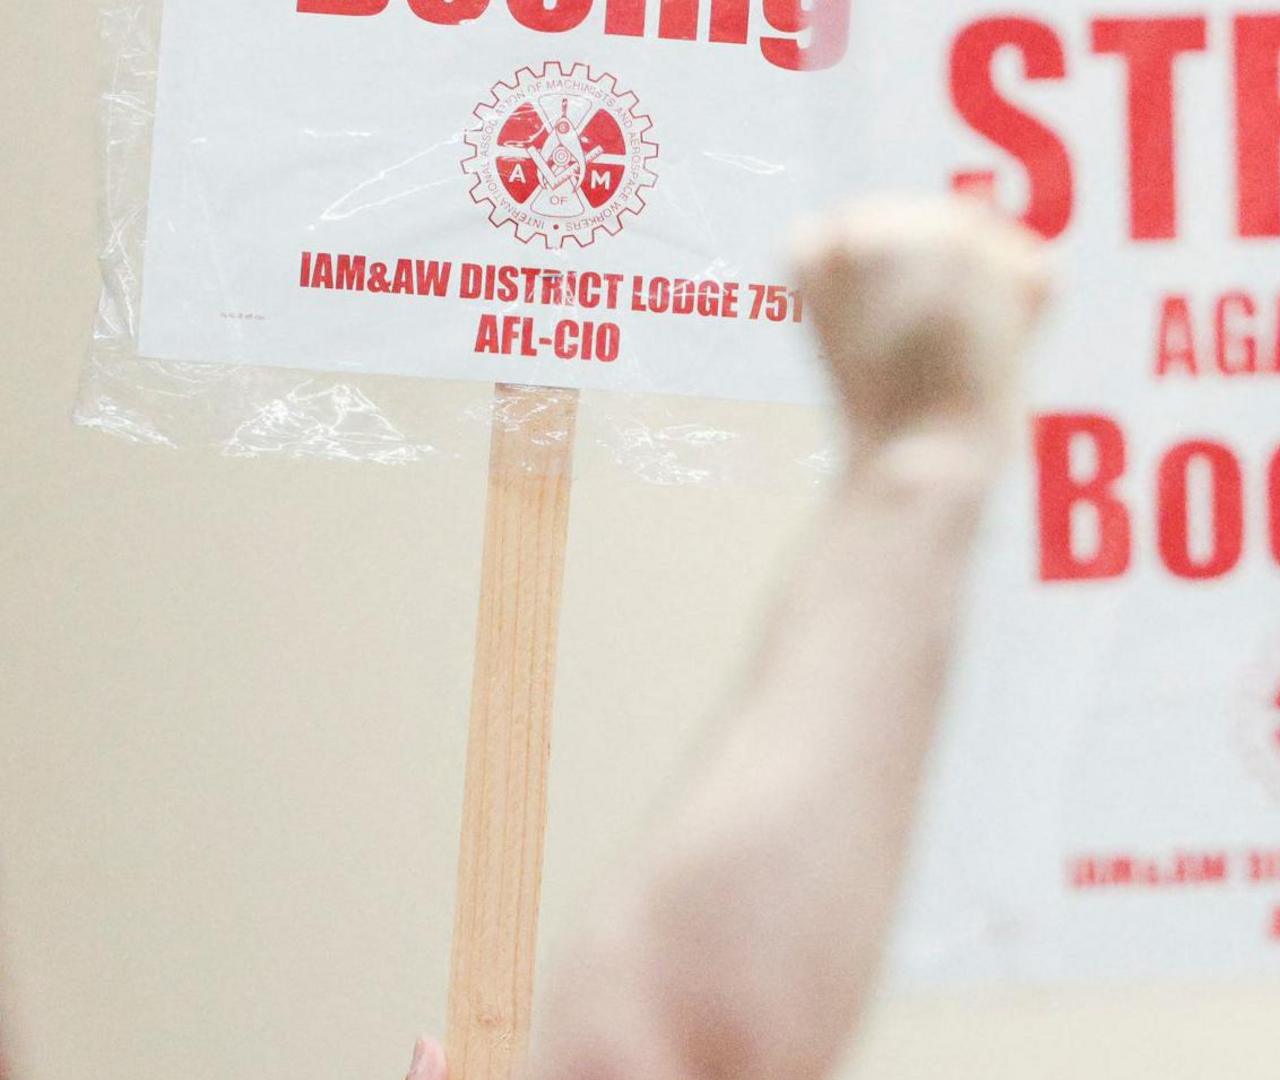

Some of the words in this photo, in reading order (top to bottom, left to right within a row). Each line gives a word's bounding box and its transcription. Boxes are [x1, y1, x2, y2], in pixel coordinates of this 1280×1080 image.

[508, 164, 527, 184] A
[590, 170, 611, 190] M
[299, 251, 452, 298] IAM&AW
[459, 262, 624, 311] DISTRICT
[631, 275, 739, 318] LODGE
[748, 283, 803, 323] 751
[474, 314, 621, 363] AFL-CIO
